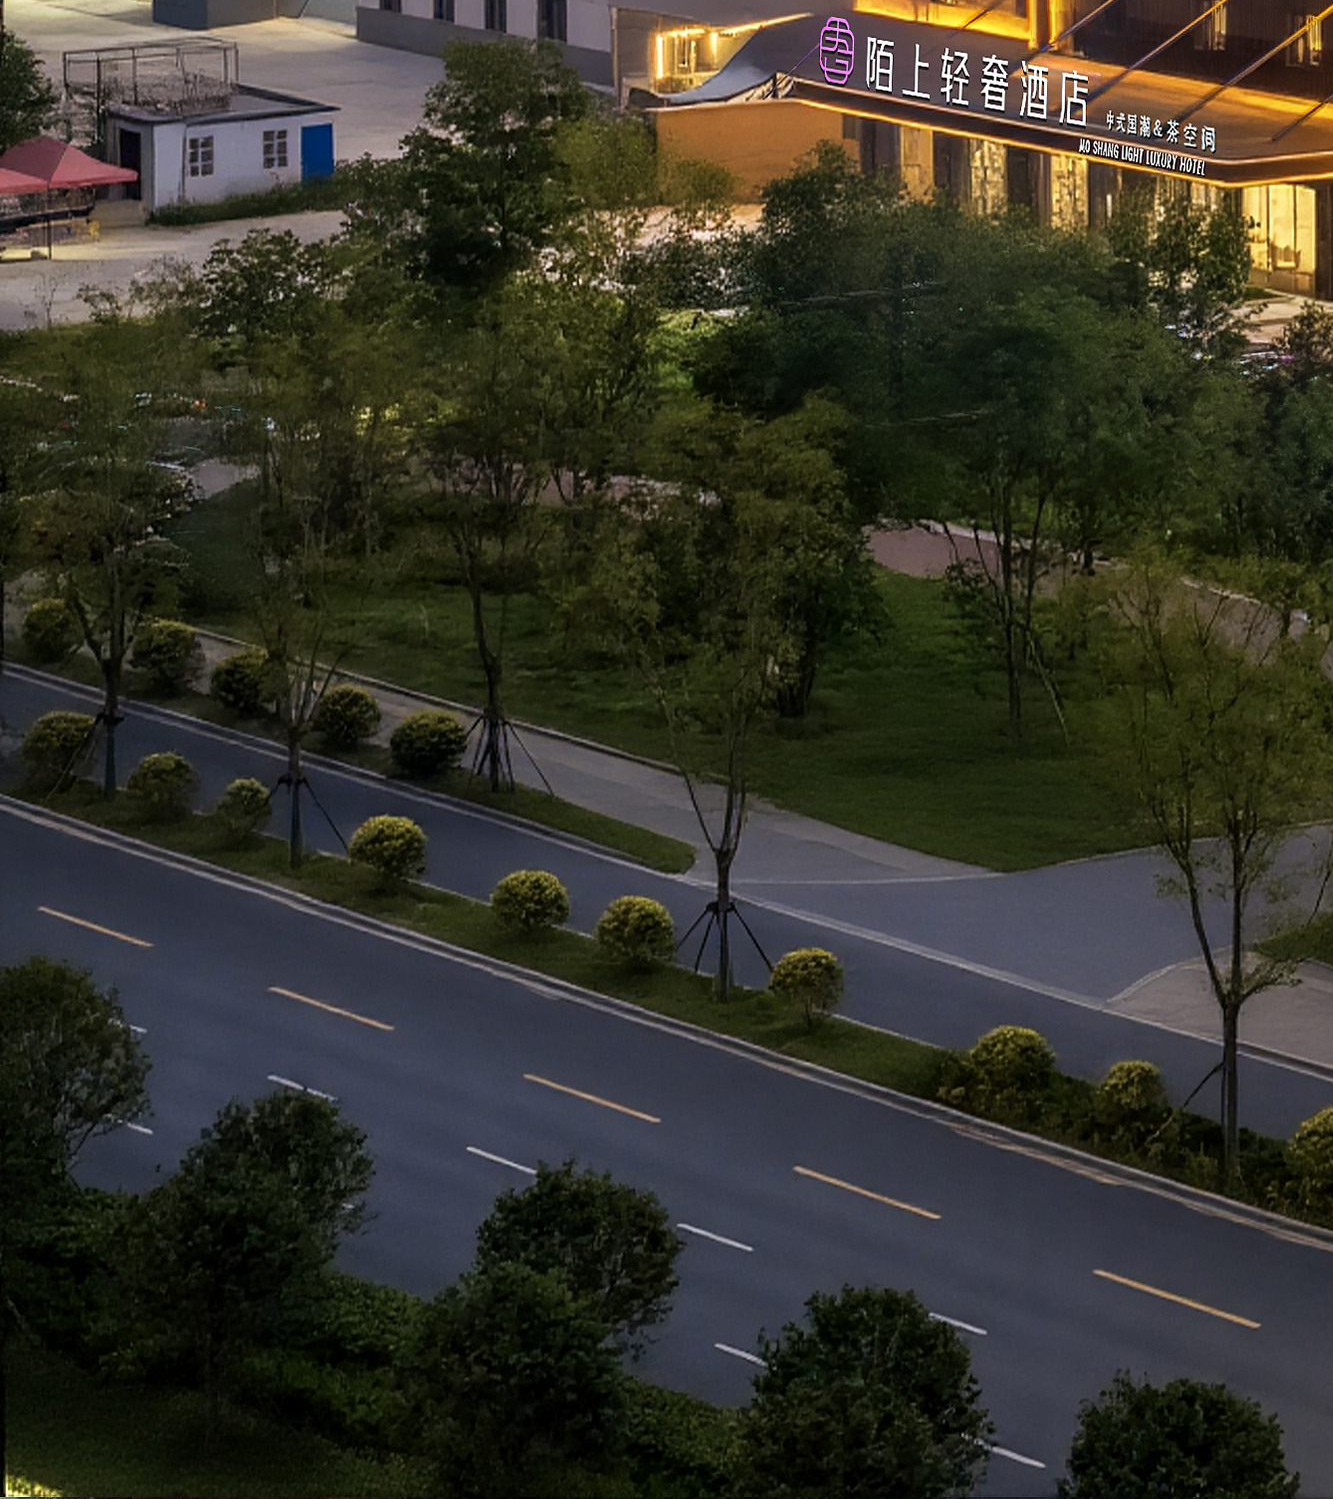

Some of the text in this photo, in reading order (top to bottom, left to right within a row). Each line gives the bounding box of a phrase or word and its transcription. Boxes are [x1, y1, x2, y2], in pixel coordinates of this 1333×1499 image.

[865, 36, 1089, 127] 陌上轻奢酒店
[1093, 141, 1119, 159] SHANG
[1121, 145, 1144, 166] LIGHT
[1146, 149, 1178, 171] LUXURY
[1179, 156, 1206, 176] HOTEL
